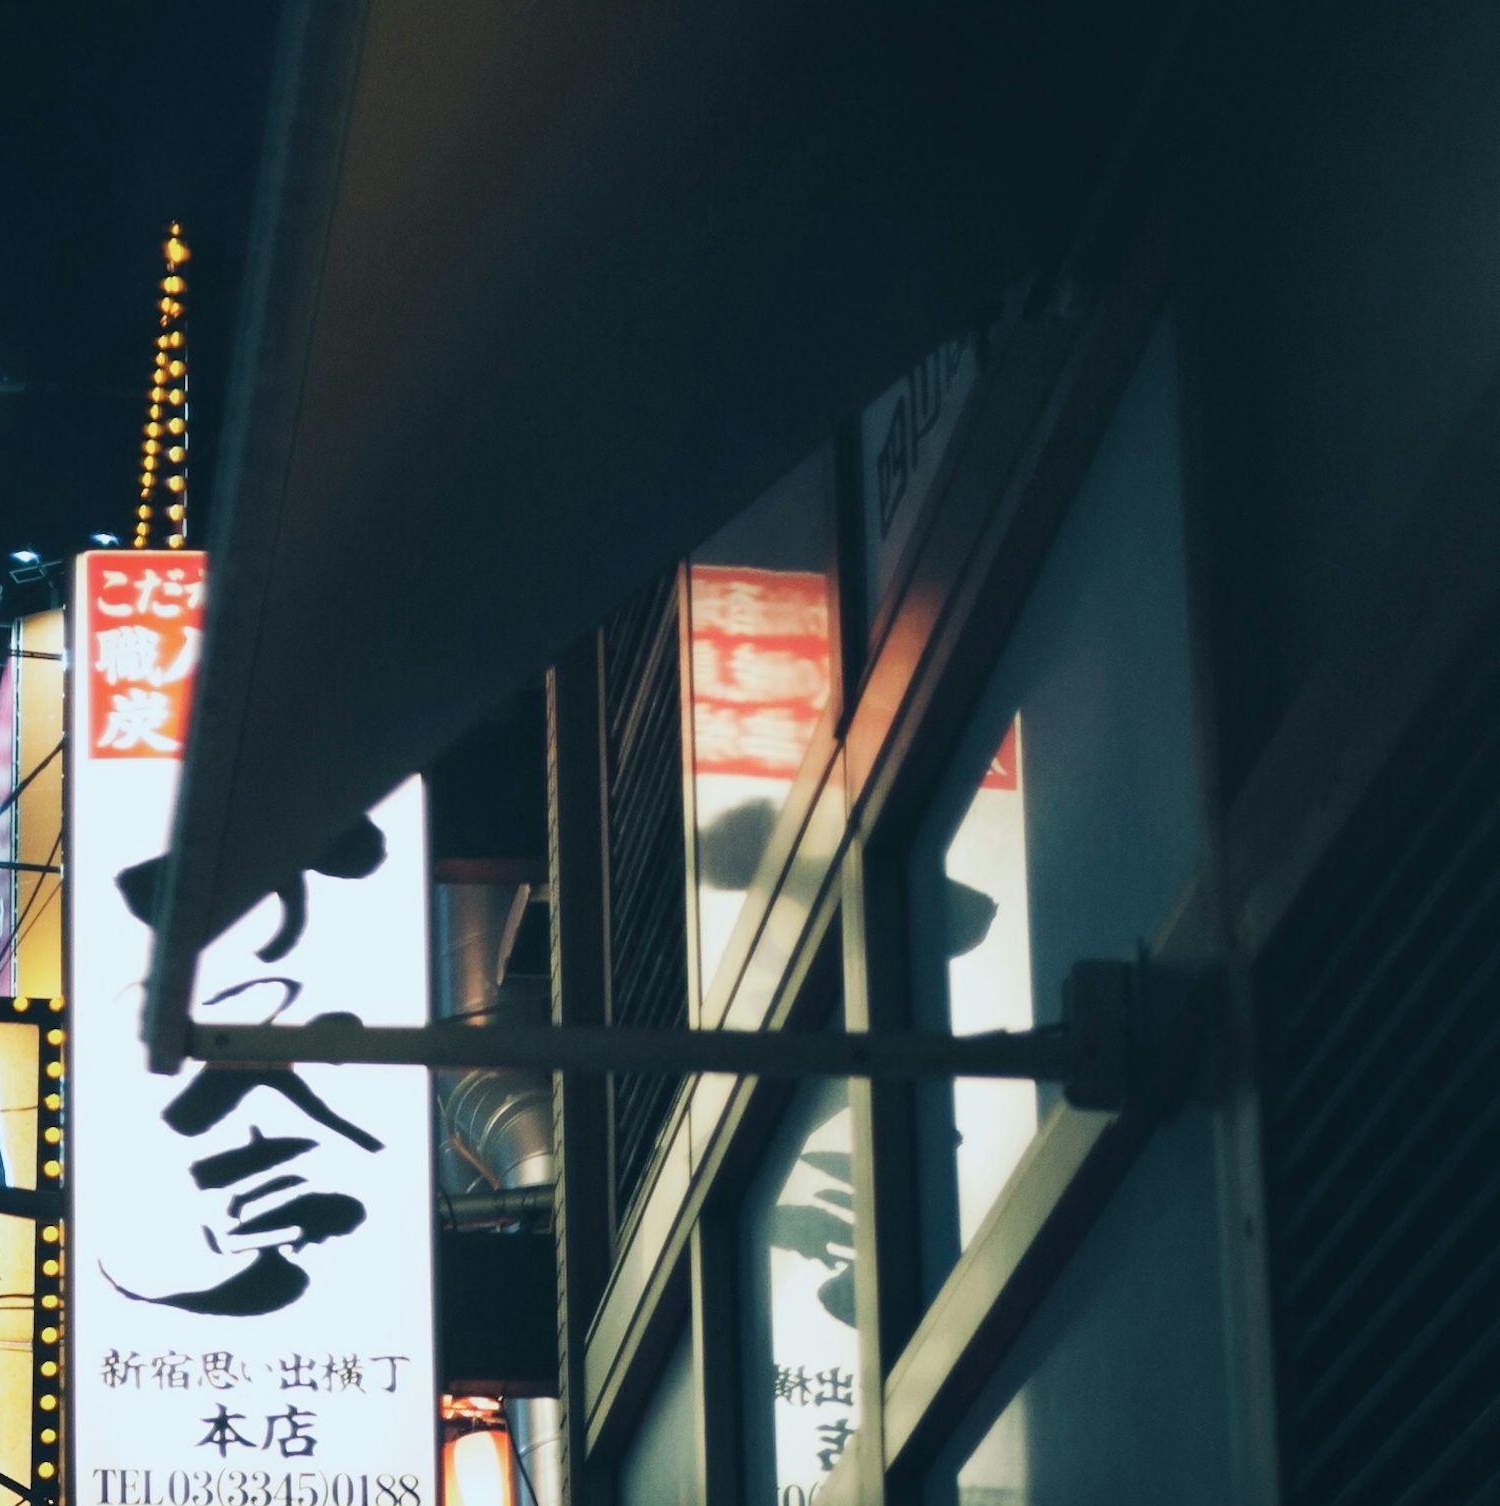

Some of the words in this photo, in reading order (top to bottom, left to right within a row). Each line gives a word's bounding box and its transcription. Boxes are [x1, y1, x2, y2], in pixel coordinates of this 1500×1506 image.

[101, 1349, 411, 1393] 新宿思い出横丁
[196, 1403, 319, 1458] 本店
